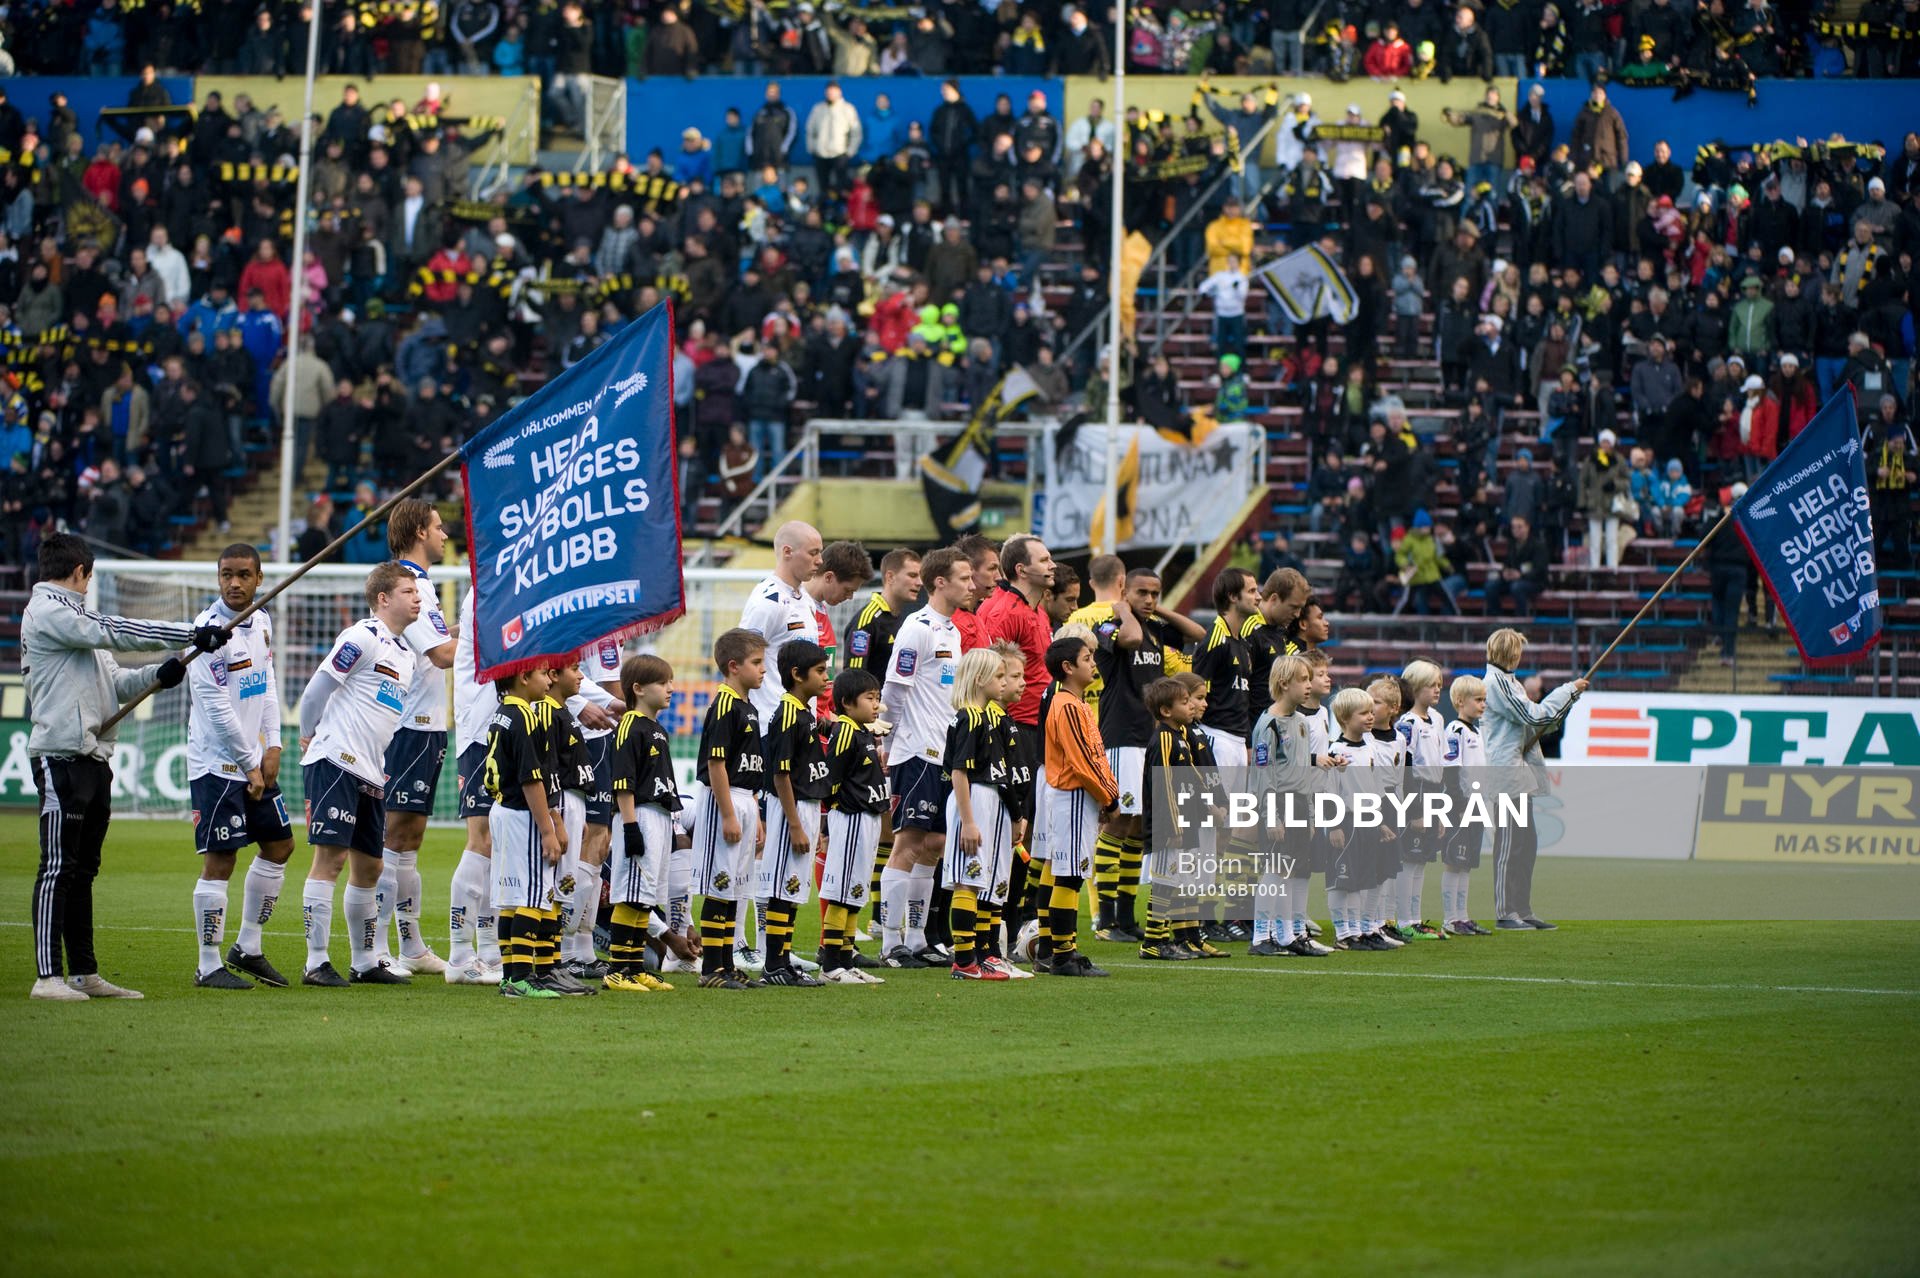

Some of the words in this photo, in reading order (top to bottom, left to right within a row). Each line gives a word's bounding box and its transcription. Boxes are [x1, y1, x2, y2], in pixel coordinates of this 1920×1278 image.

[521, 399, 593, 439] VÄLKOMMEN
[530, 415, 599, 485] HELA
[499, 437, 640, 539] SVERIGES
[1772, 459, 1824, 495] VÄLKOMMEN
[1788, 473, 1849, 525] HELA
[495, 478, 650, 577] FOTBOLLS
[514, 525, 619, 596] KLUBB
[525, 580, 639, 631] STRYKTIPSET
[415, 716, 430, 725] 1882
[222, 764, 238, 773] 1882
[341, 752, 356, 765] 1882
[396, 791, 409, 804] 15
[465, 796, 476, 808] 16
[214, 826, 230, 841] 18
[311, 822, 324, 836] 17
[1339, 863, 1347, 874] 3
